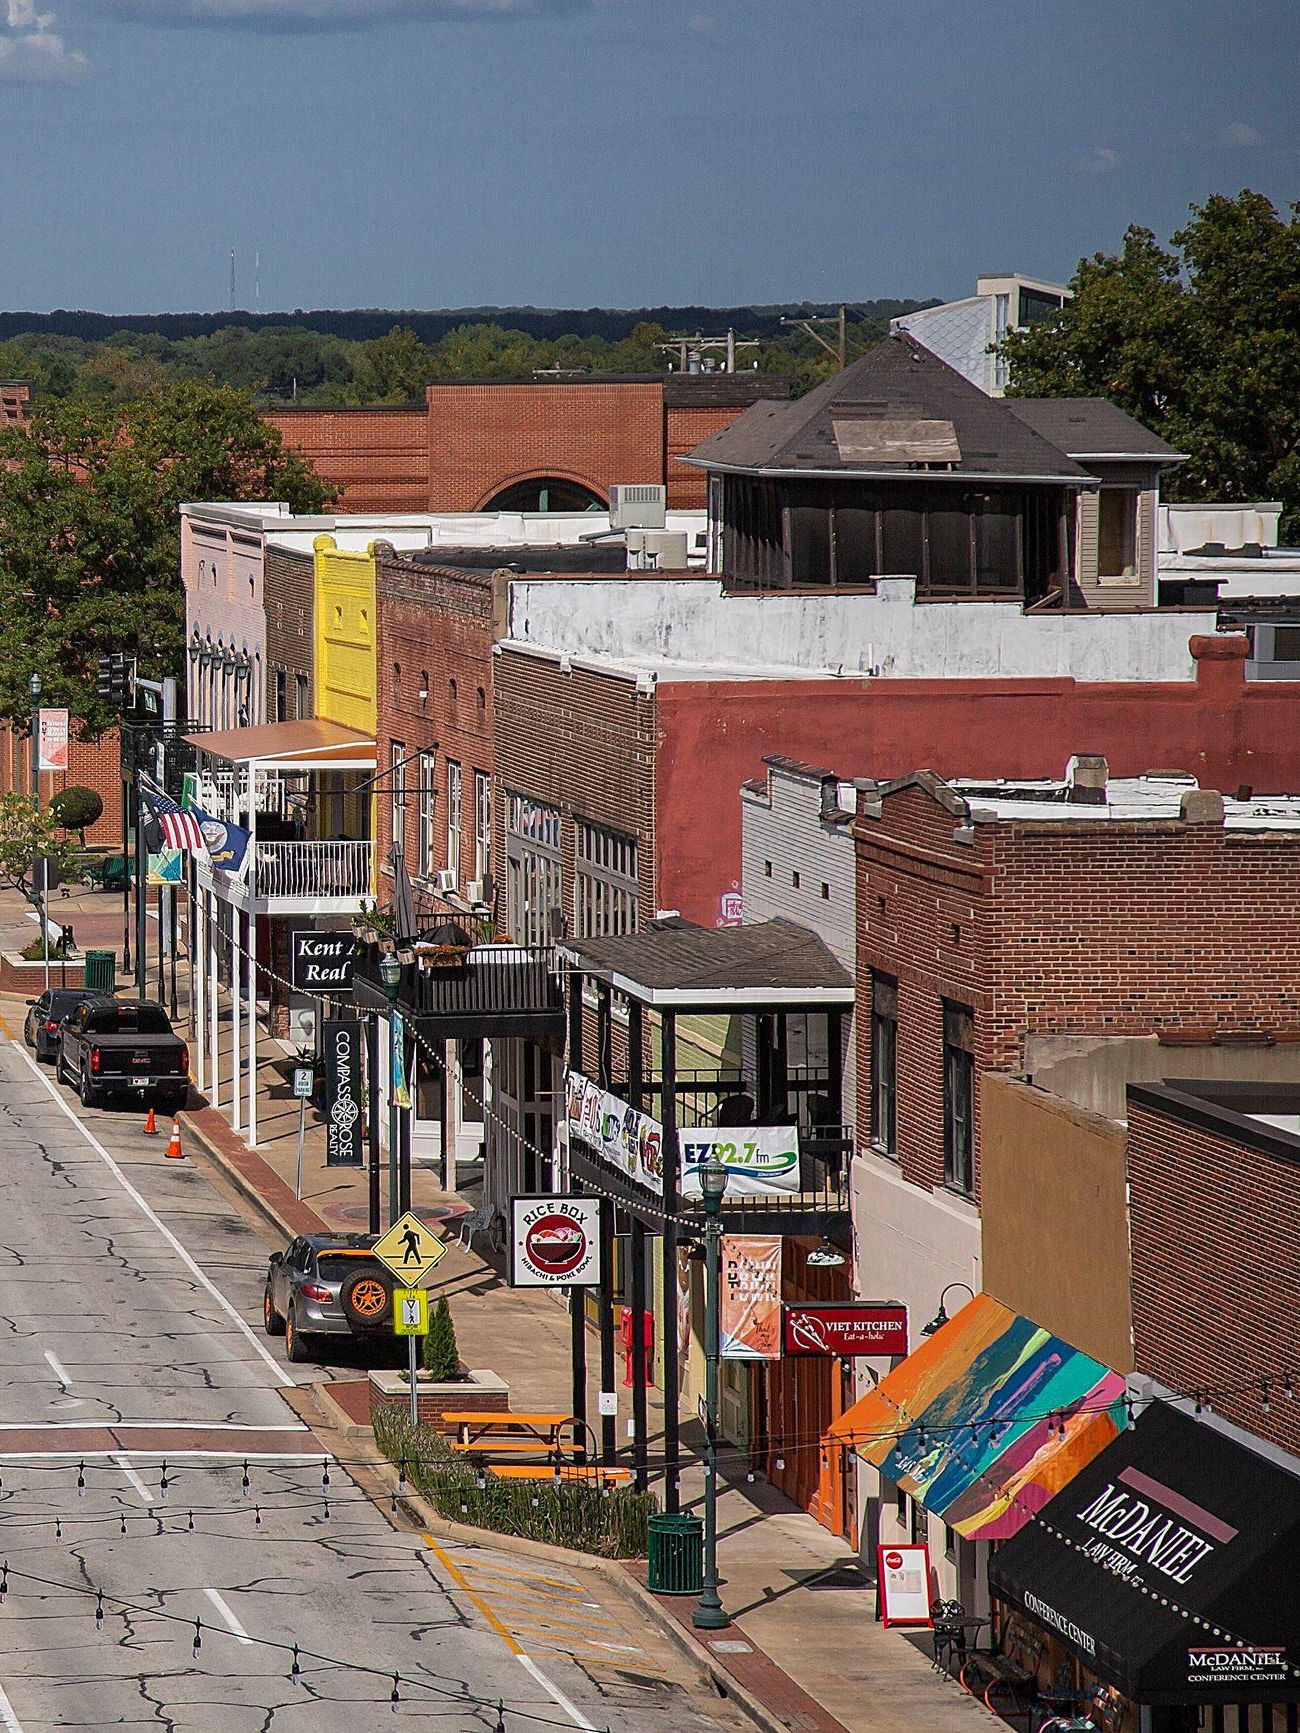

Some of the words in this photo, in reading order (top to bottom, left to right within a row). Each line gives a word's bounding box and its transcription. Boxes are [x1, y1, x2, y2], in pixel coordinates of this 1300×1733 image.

[298, 939, 344, 956] Kent
[306, 960, 352, 981] Real
[301, 1071, 308, 1081] 2
[336, 1030, 351, 1101] COMPASS
[329, 1123, 338, 1156] REALTY
[338, 1122, 353, 1157] ROSE
[523, 1203, 555, 1226] RICE
[560, 1203, 588, 1225] BOX
[521, 1257, 549, 1281] HIBACHI
[557, 1271, 577, 1282] POKE
[575, 1255, 593, 1274] BOWL
[825, 1322, 852, 1331] VIET
[853, 1321, 903, 1331] KITCHEN
[843, 1331, 885, 1341] Eat-a-holic
[1076, 1483, 1215, 1585] McDANIEL
[1081, 1536, 1108, 1563] LAW
[1024, 1590, 1069, 1635] CONFERENCE
[1068, 1622, 1097, 1657] CENTER
[1188, 1653, 1286, 1667] McDANIEL
[1187, 1674, 1249, 1683] CONFERENCE
[1250, 1673, 1286, 1681] CENTER
